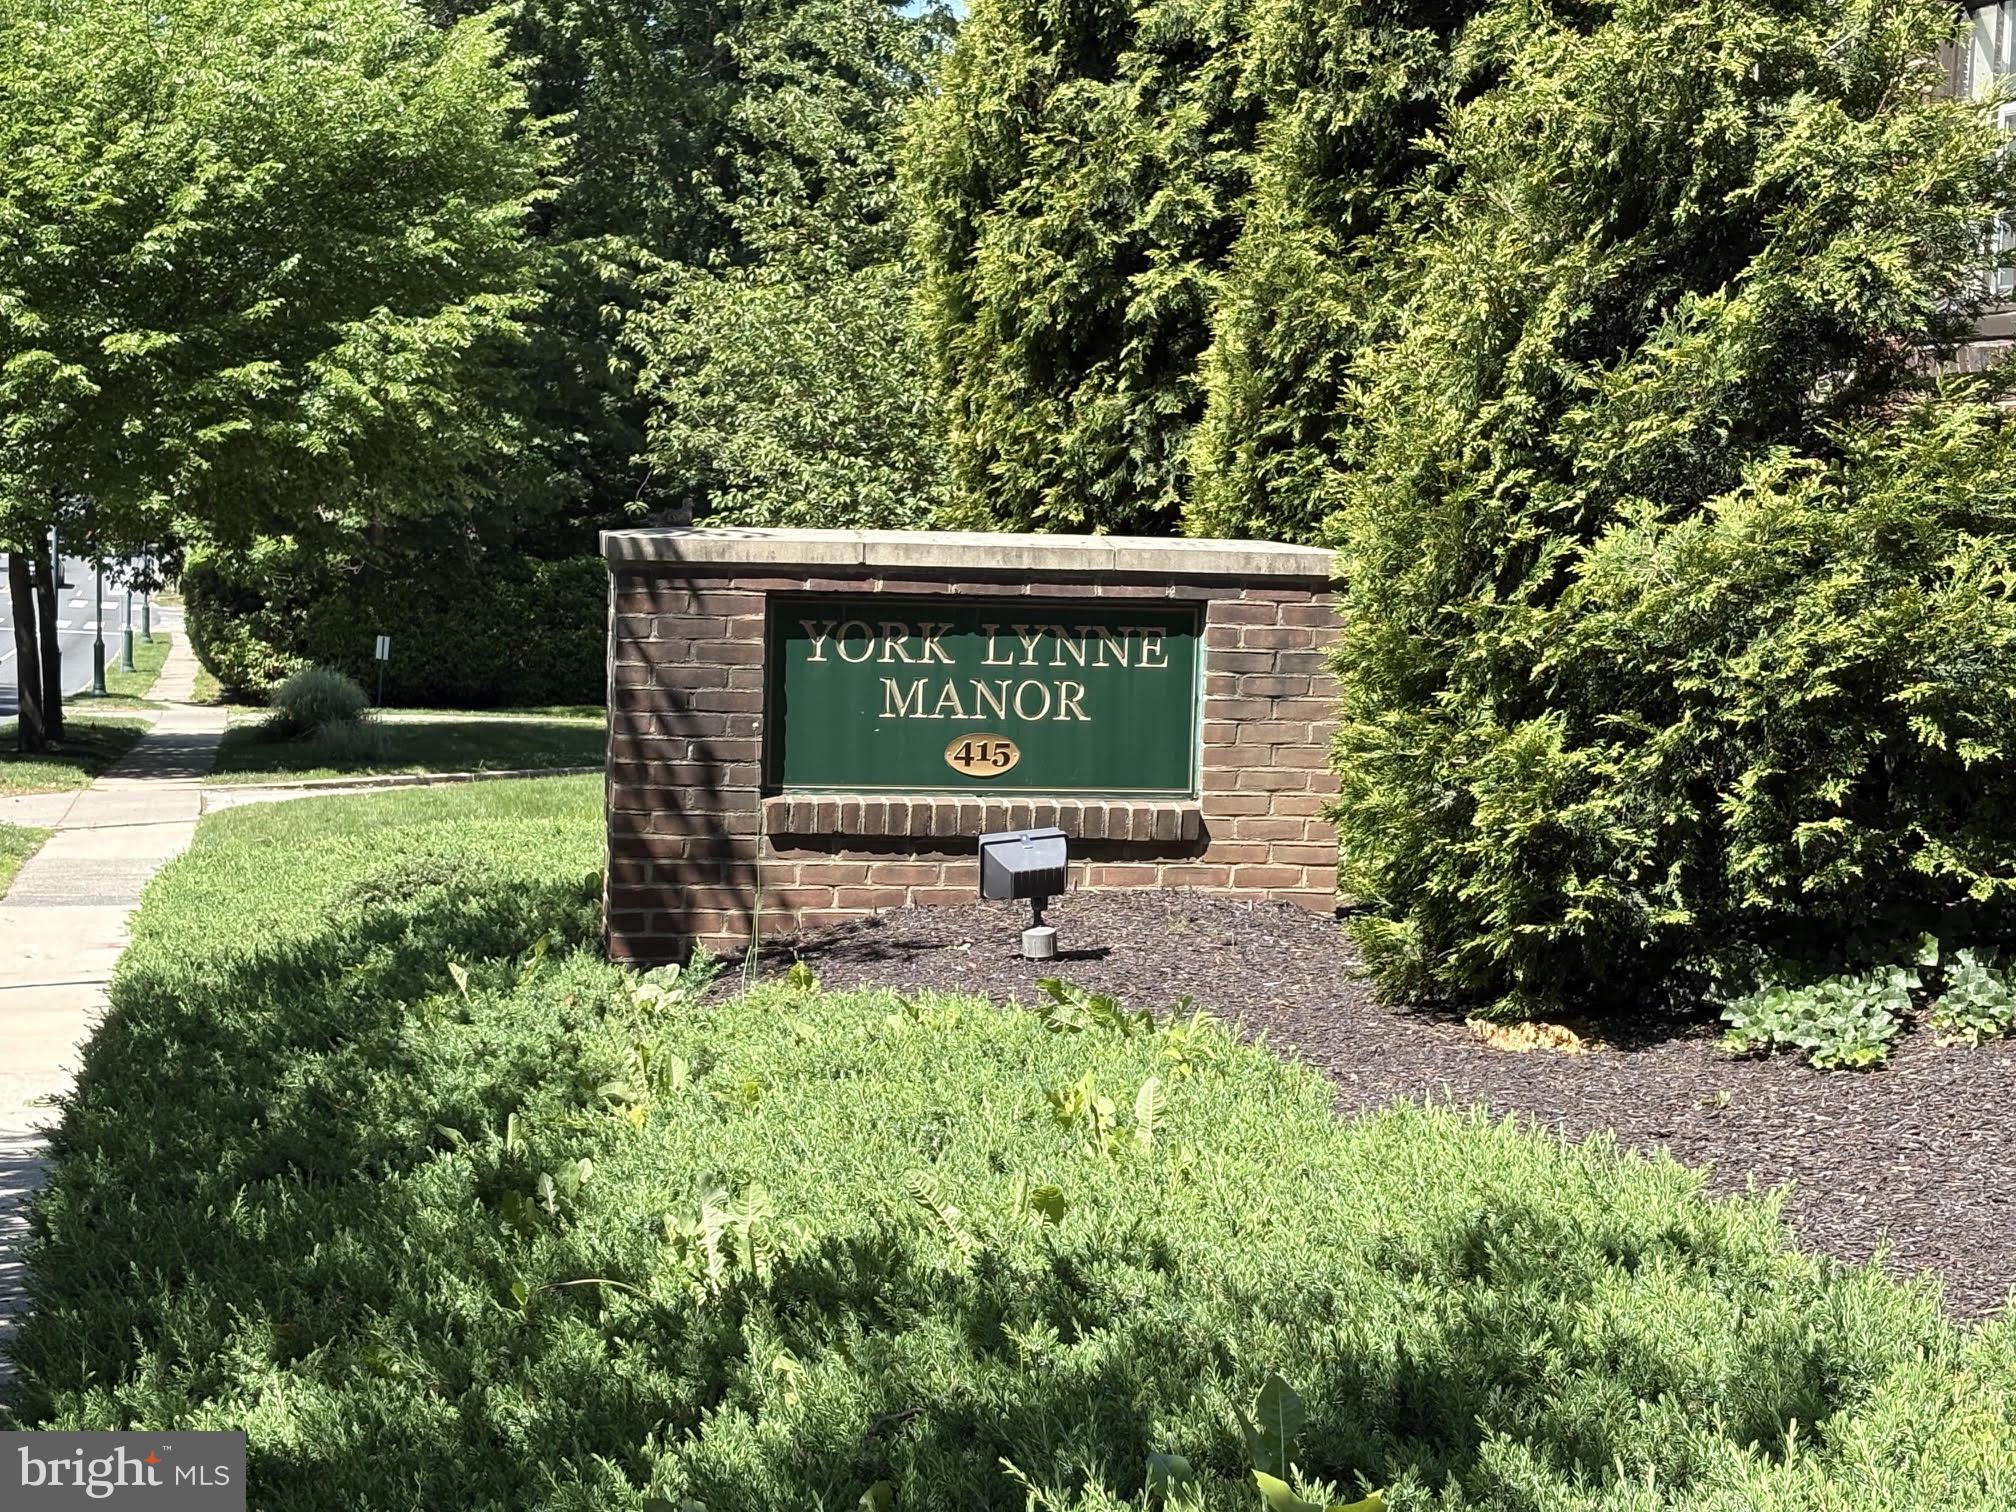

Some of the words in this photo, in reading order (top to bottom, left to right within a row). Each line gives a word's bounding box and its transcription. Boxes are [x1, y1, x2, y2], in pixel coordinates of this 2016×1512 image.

[800, 620, 955, 664] YORK
[981, 623, 1169, 668] LYNNE
[879, 677, 1091, 721] MANOR
[953, 740, 1011, 768] 415
